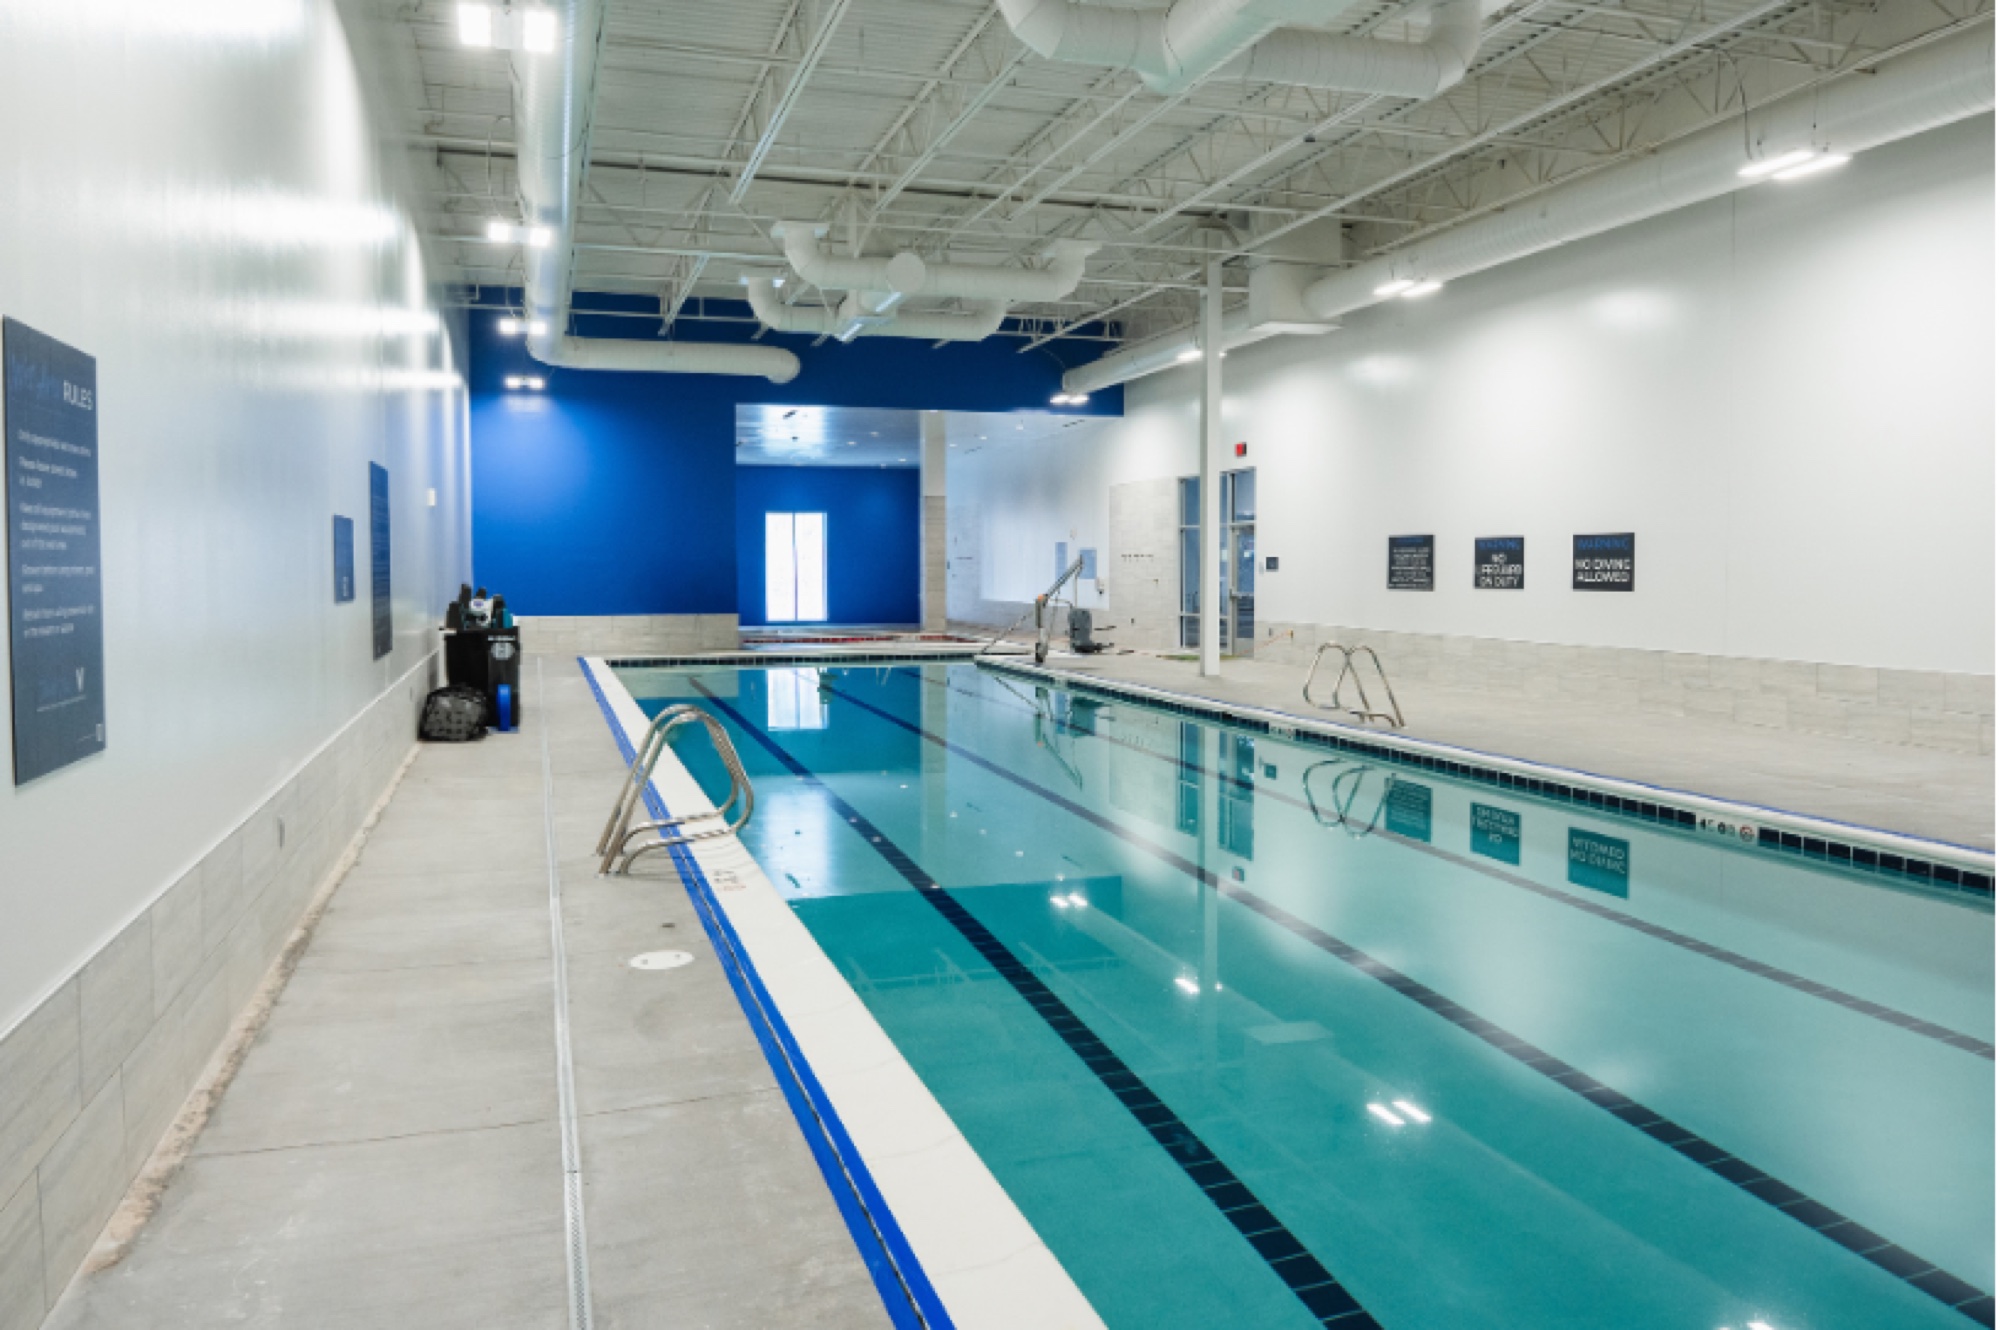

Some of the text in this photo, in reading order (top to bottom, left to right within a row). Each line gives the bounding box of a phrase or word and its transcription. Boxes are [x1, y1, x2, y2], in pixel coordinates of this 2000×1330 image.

[63, 380, 93, 411] RULES
[1491, 553, 1507, 564] NO
[1575, 558, 1630, 570] NO DIVING
[1576, 571, 1630, 582] ALLOWED
